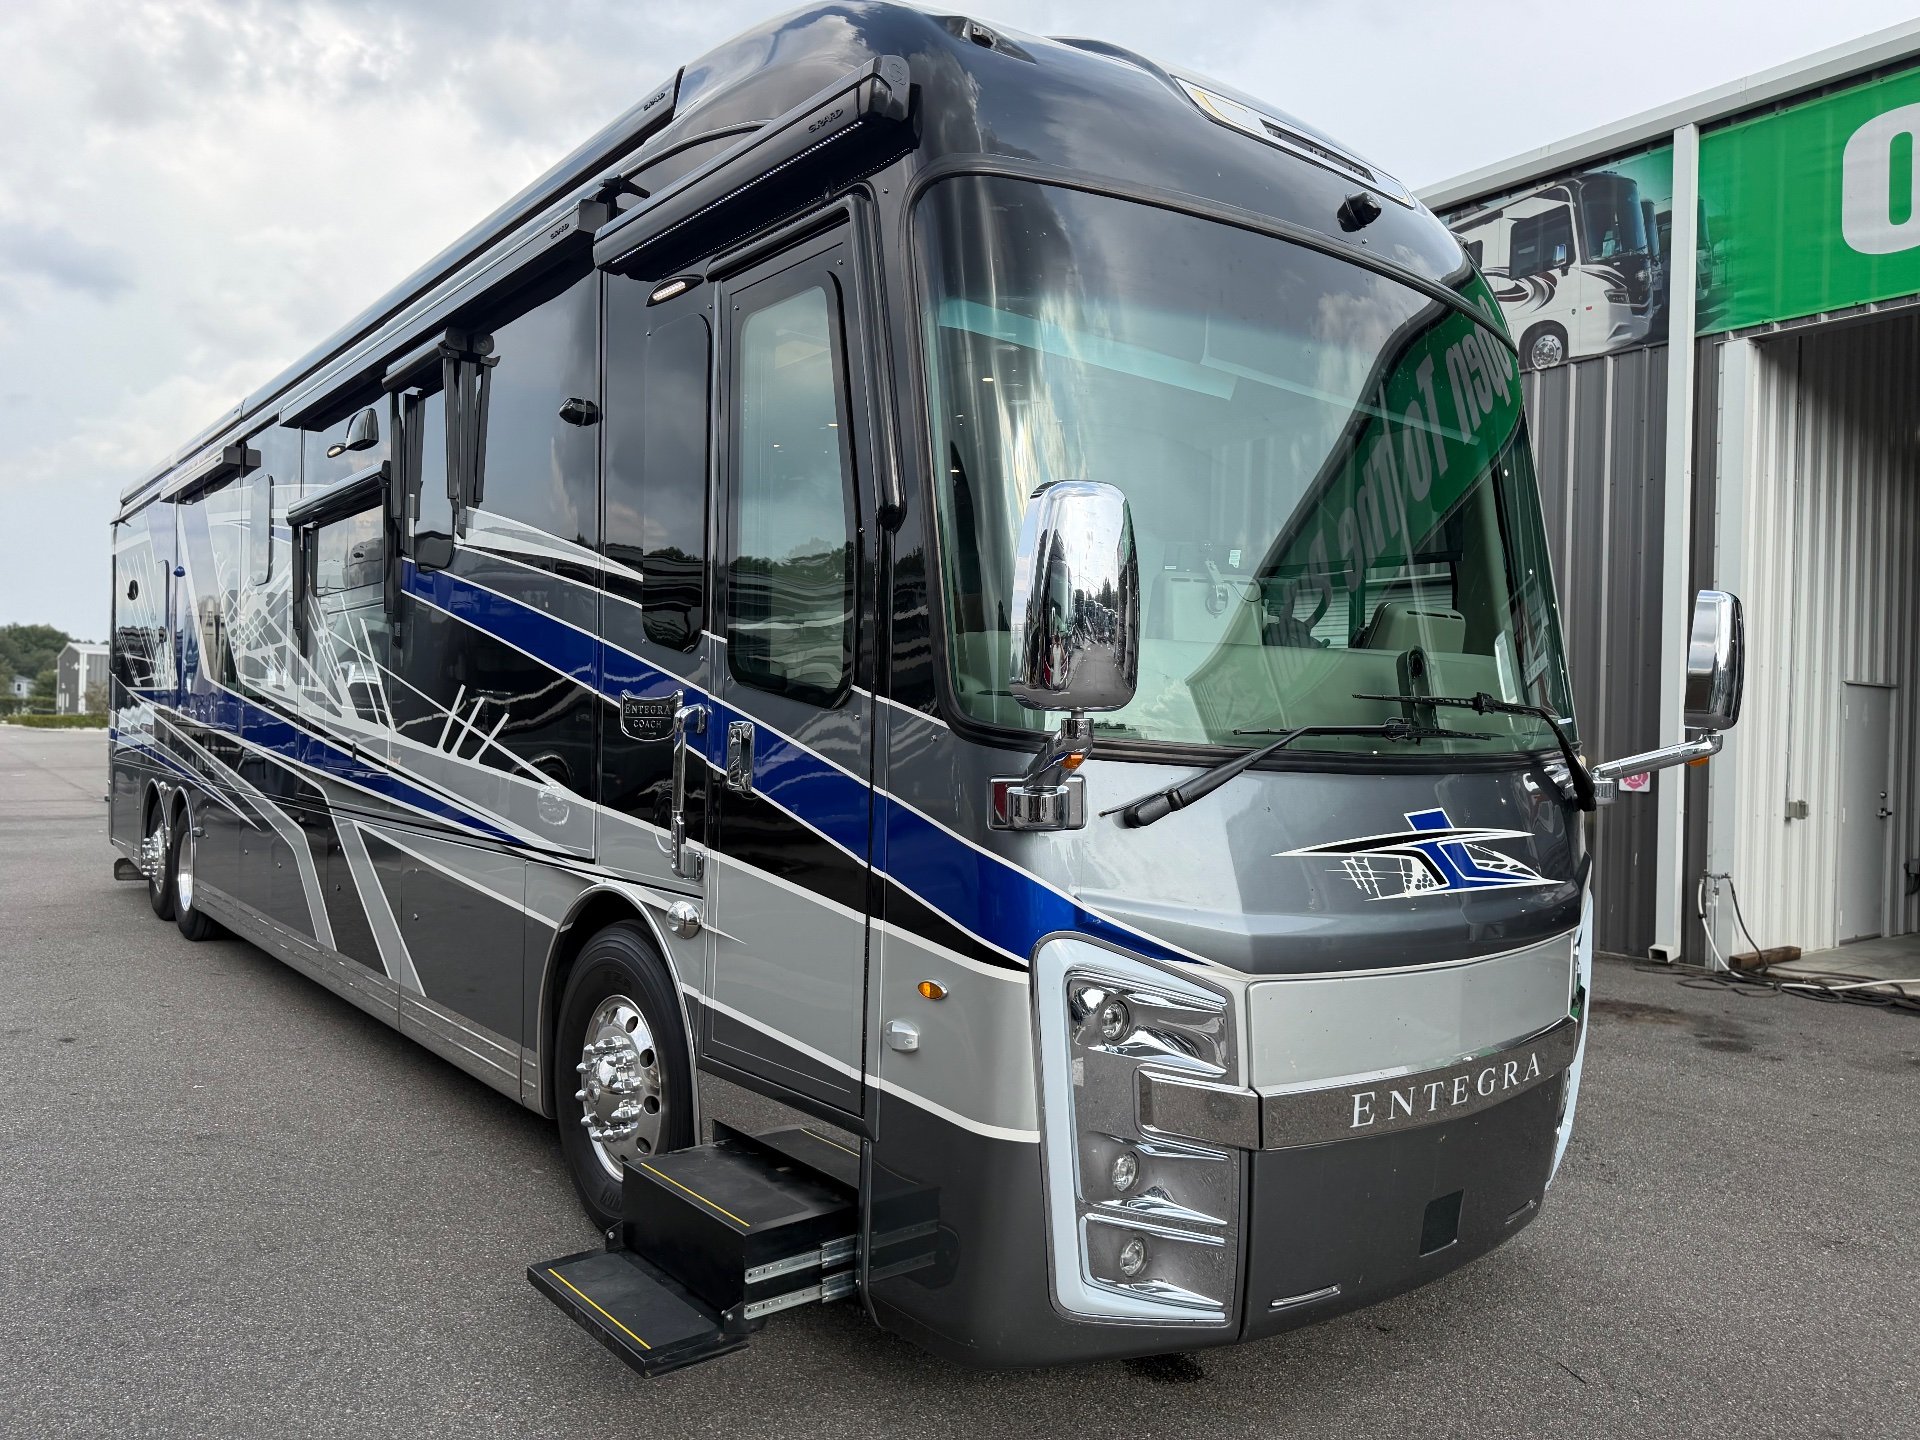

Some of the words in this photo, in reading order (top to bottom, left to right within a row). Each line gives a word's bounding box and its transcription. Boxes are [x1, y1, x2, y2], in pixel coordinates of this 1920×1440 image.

[624, 703, 671, 715] ENTEGRA
[633, 719, 662, 729] COACH
[1350, 1052, 1541, 1128] ENTEGRA
